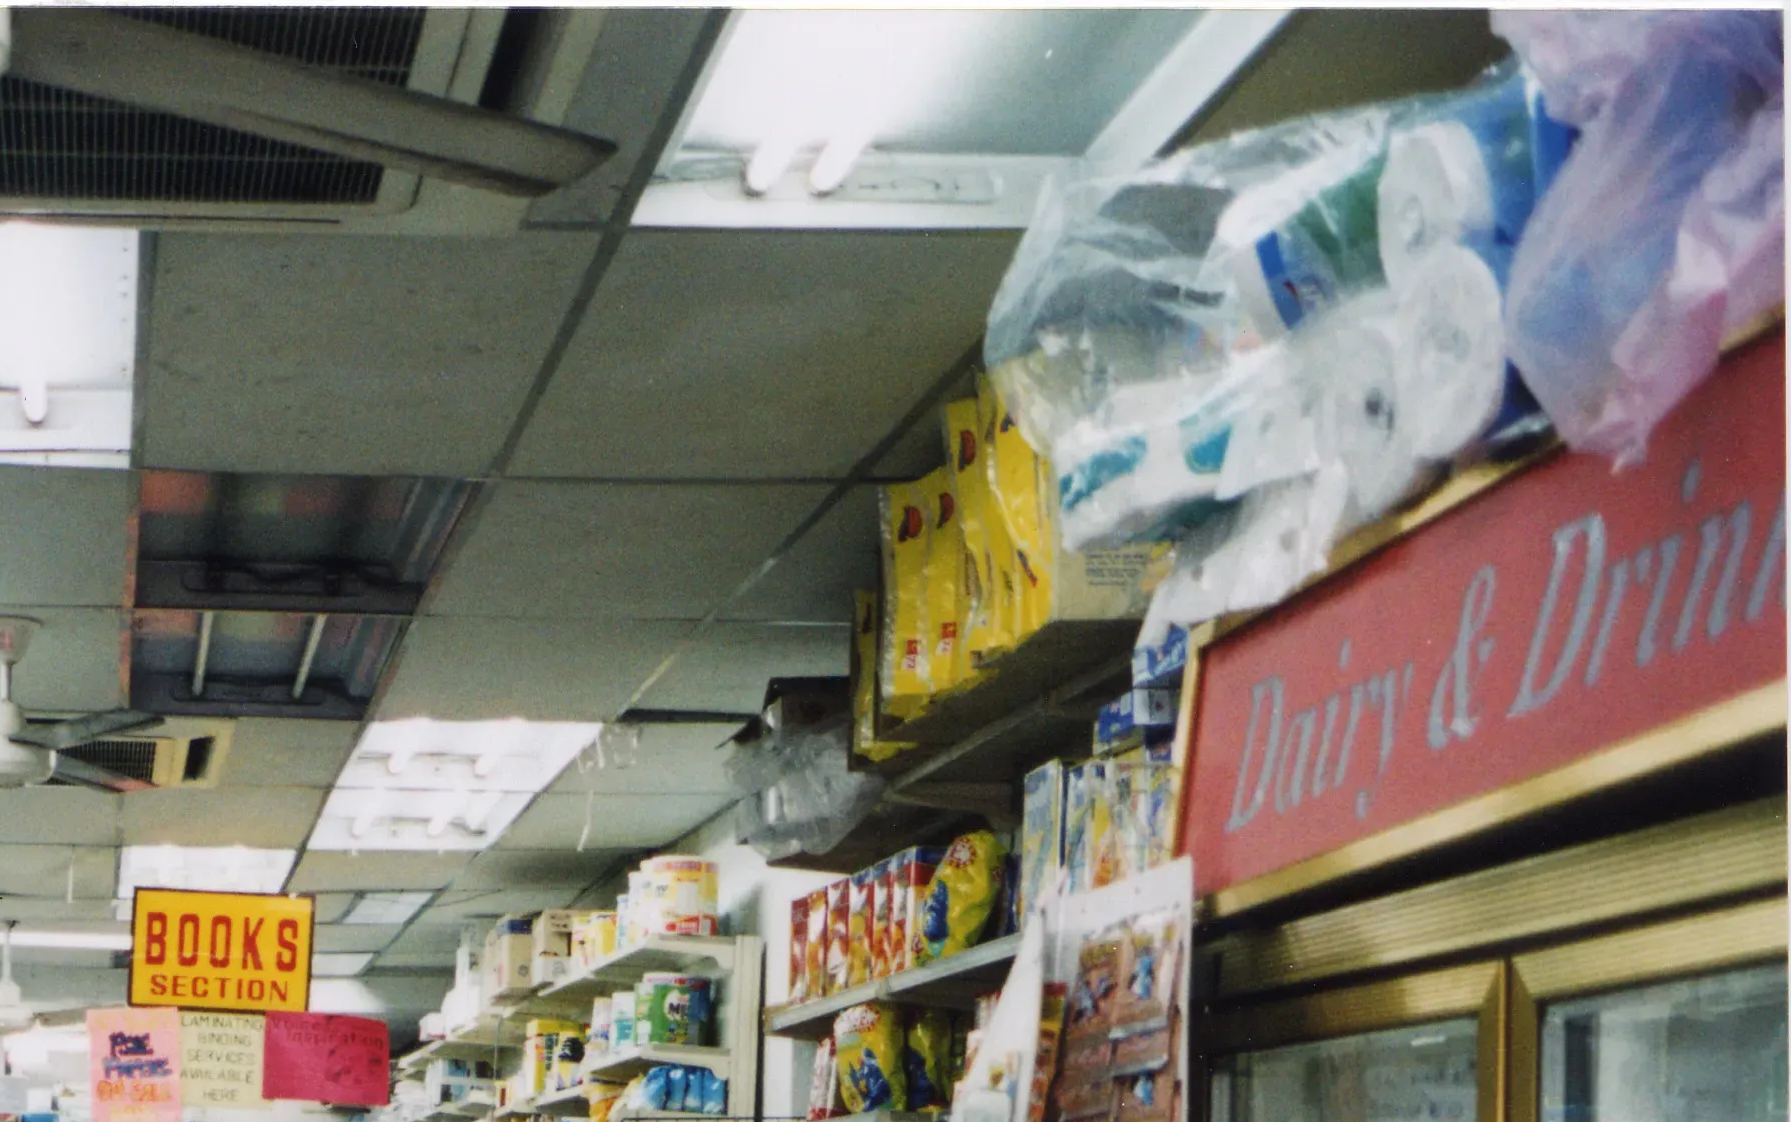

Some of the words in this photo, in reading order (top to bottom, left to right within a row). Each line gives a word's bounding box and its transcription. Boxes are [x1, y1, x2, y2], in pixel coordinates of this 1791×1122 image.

[1225, 638, 1414, 832] Dairy
[1427, 564, 1496, 752] &
[146, 912, 299, 972] BOOKS
[150, 974, 288, 1002] SECTION
[181, 1015, 264, 1032] LAMINATING
[198, 1032, 252, 1047] BINDING
[188, 1050, 255, 1064] SERVICES
[180, 1070, 254, 1084] AVAILABLE
[203, 1089, 240, 1101] HERE
